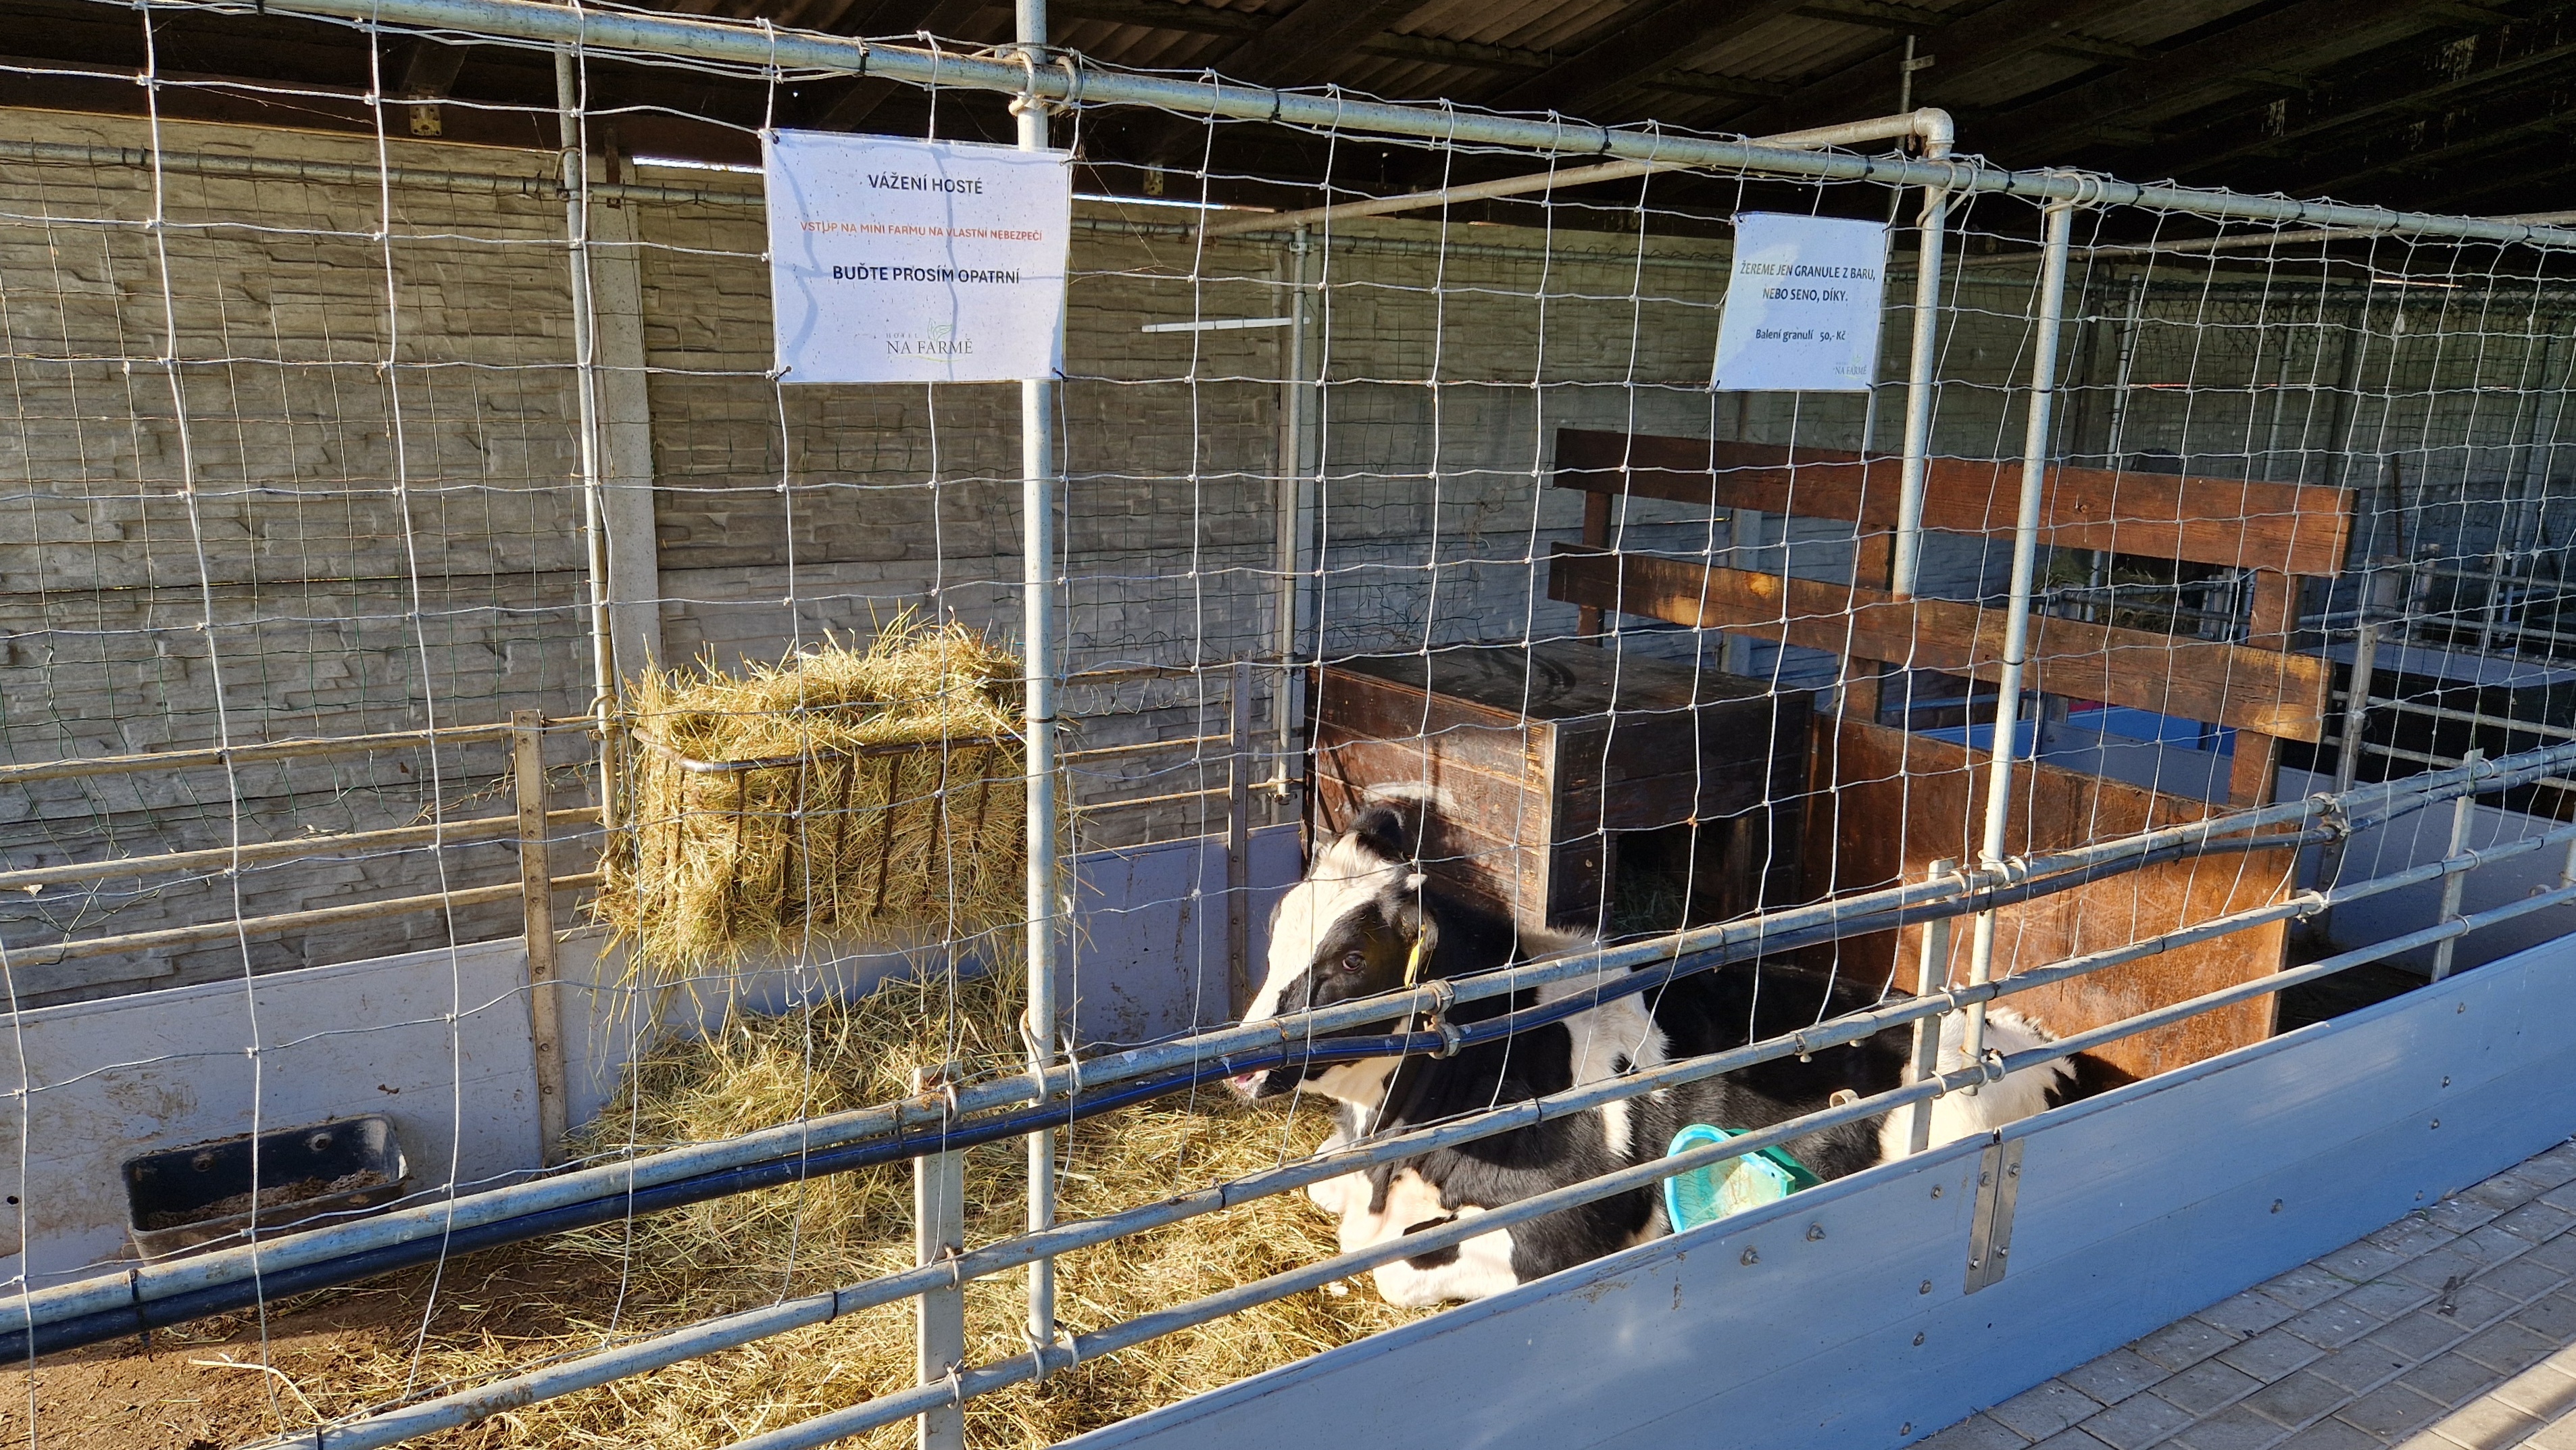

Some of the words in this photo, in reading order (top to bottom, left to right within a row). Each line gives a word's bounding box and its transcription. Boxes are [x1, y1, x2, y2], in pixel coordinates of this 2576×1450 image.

[868, 171, 927, 191] VÁŽENÍ
[932, 177, 983, 194] HOSTÉ
[800, 222, 838, 234] VSTUP
[841, 223, 857, 232] NA
[861, 224, 885, 234] MINI
[889, 225, 926, 236] FARMU
[928, 226, 943, 236] NA
[946, 227, 987, 238] VLASTNÍ
[991, 229, 1042, 241] NEBEZPEČÍ
[833, 263, 889, 280] BUĎTE
[893, 266, 954, 282] PROSÍM
[958, 268, 1019, 284] OPATRNÍ
[1740, 260, 1775, 276] ŽEREME
[1776, 264, 1792, 276] JEN
[1795, 265, 1840, 278] GRANULE
[1842, 268, 1848, 278] Z
[1850, 268, 1875, 282] BARU,
[1762, 288, 1788, 299] NEBO
[1790, 289, 1820, 303] SENO,
[1823, 287, 1848, 302] DÍKY.
[1756, 328, 1782, 339] Balení
[1783, 329, 1814, 342] granulí
[1836, 330, 1846, 340] Kč
[886, 341, 911, 354] NA
[918, 338, 973, 354] FARMĚ
